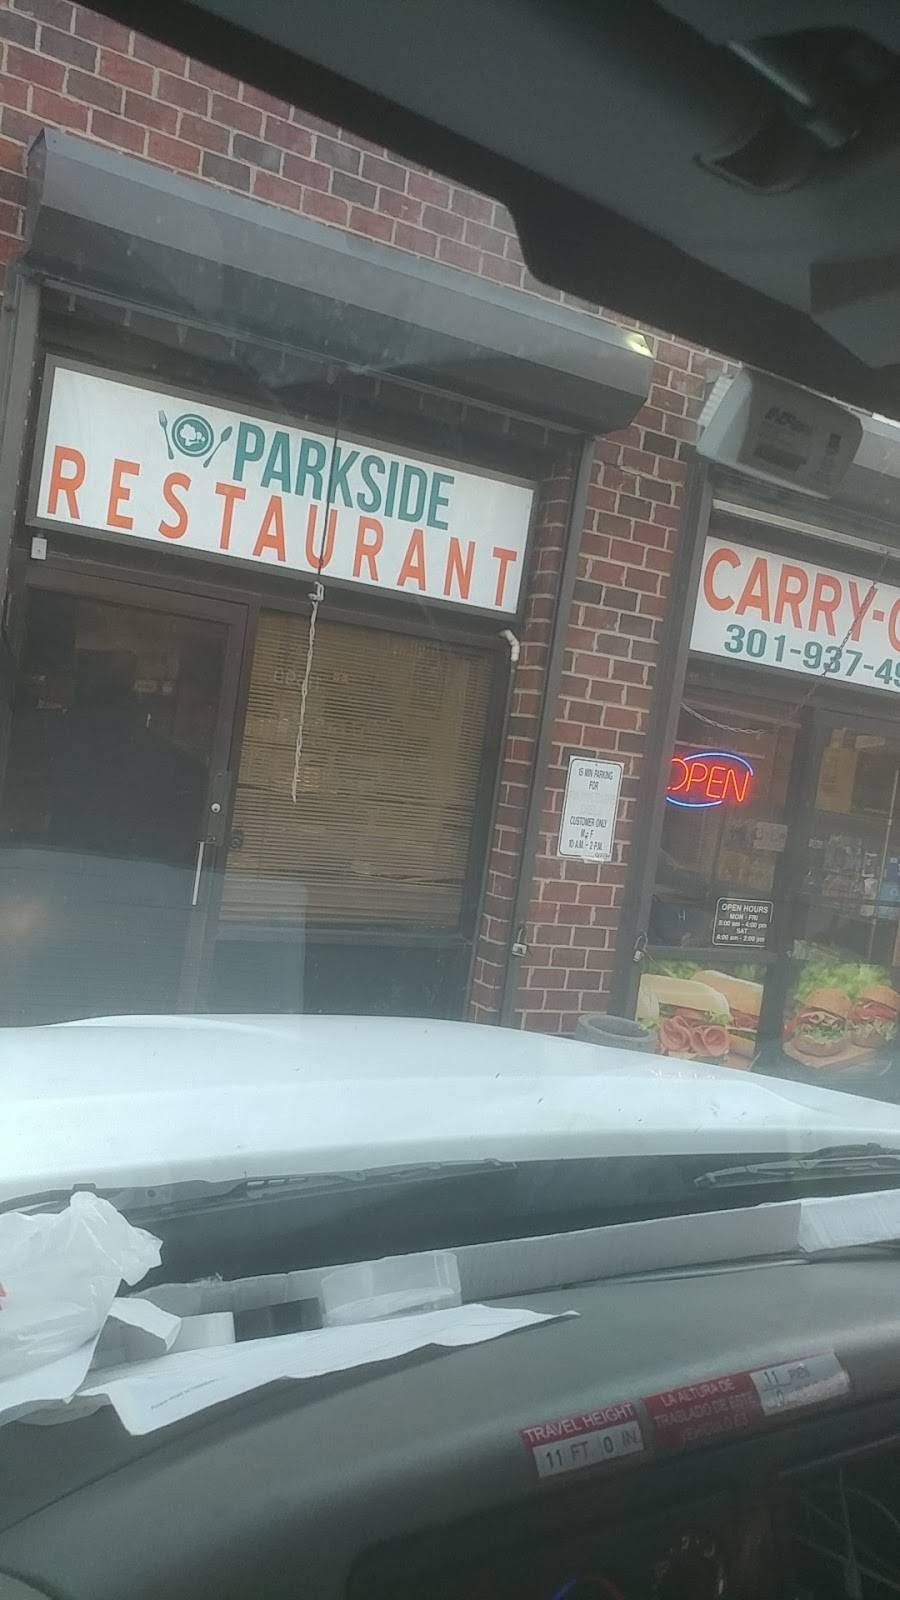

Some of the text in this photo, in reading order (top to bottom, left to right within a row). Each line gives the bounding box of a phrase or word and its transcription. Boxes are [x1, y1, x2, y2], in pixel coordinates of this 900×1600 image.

[232, 421, 455, 530] PARKSIDE
[46, 445, 518, 607] RESTAURANT
[589, 781, 599, 790] FOR
[594, 769, 613, 781] PARKING
[667, 758, 750, 802] OPEN
[570, 816, 607, 828] CUSTOMER ONLY
[721, 903, 769, 914] OPEN HOURS
[660, 1378, 736, 1407] LA ALTURA DE
[523, 1403, 635, 1442] TRAVEL HEIGHT
[545, 1449, 563, 1469] 11
[570, 1441, 589, 1459] FT
[603, 1435, 614, 1454] 0
